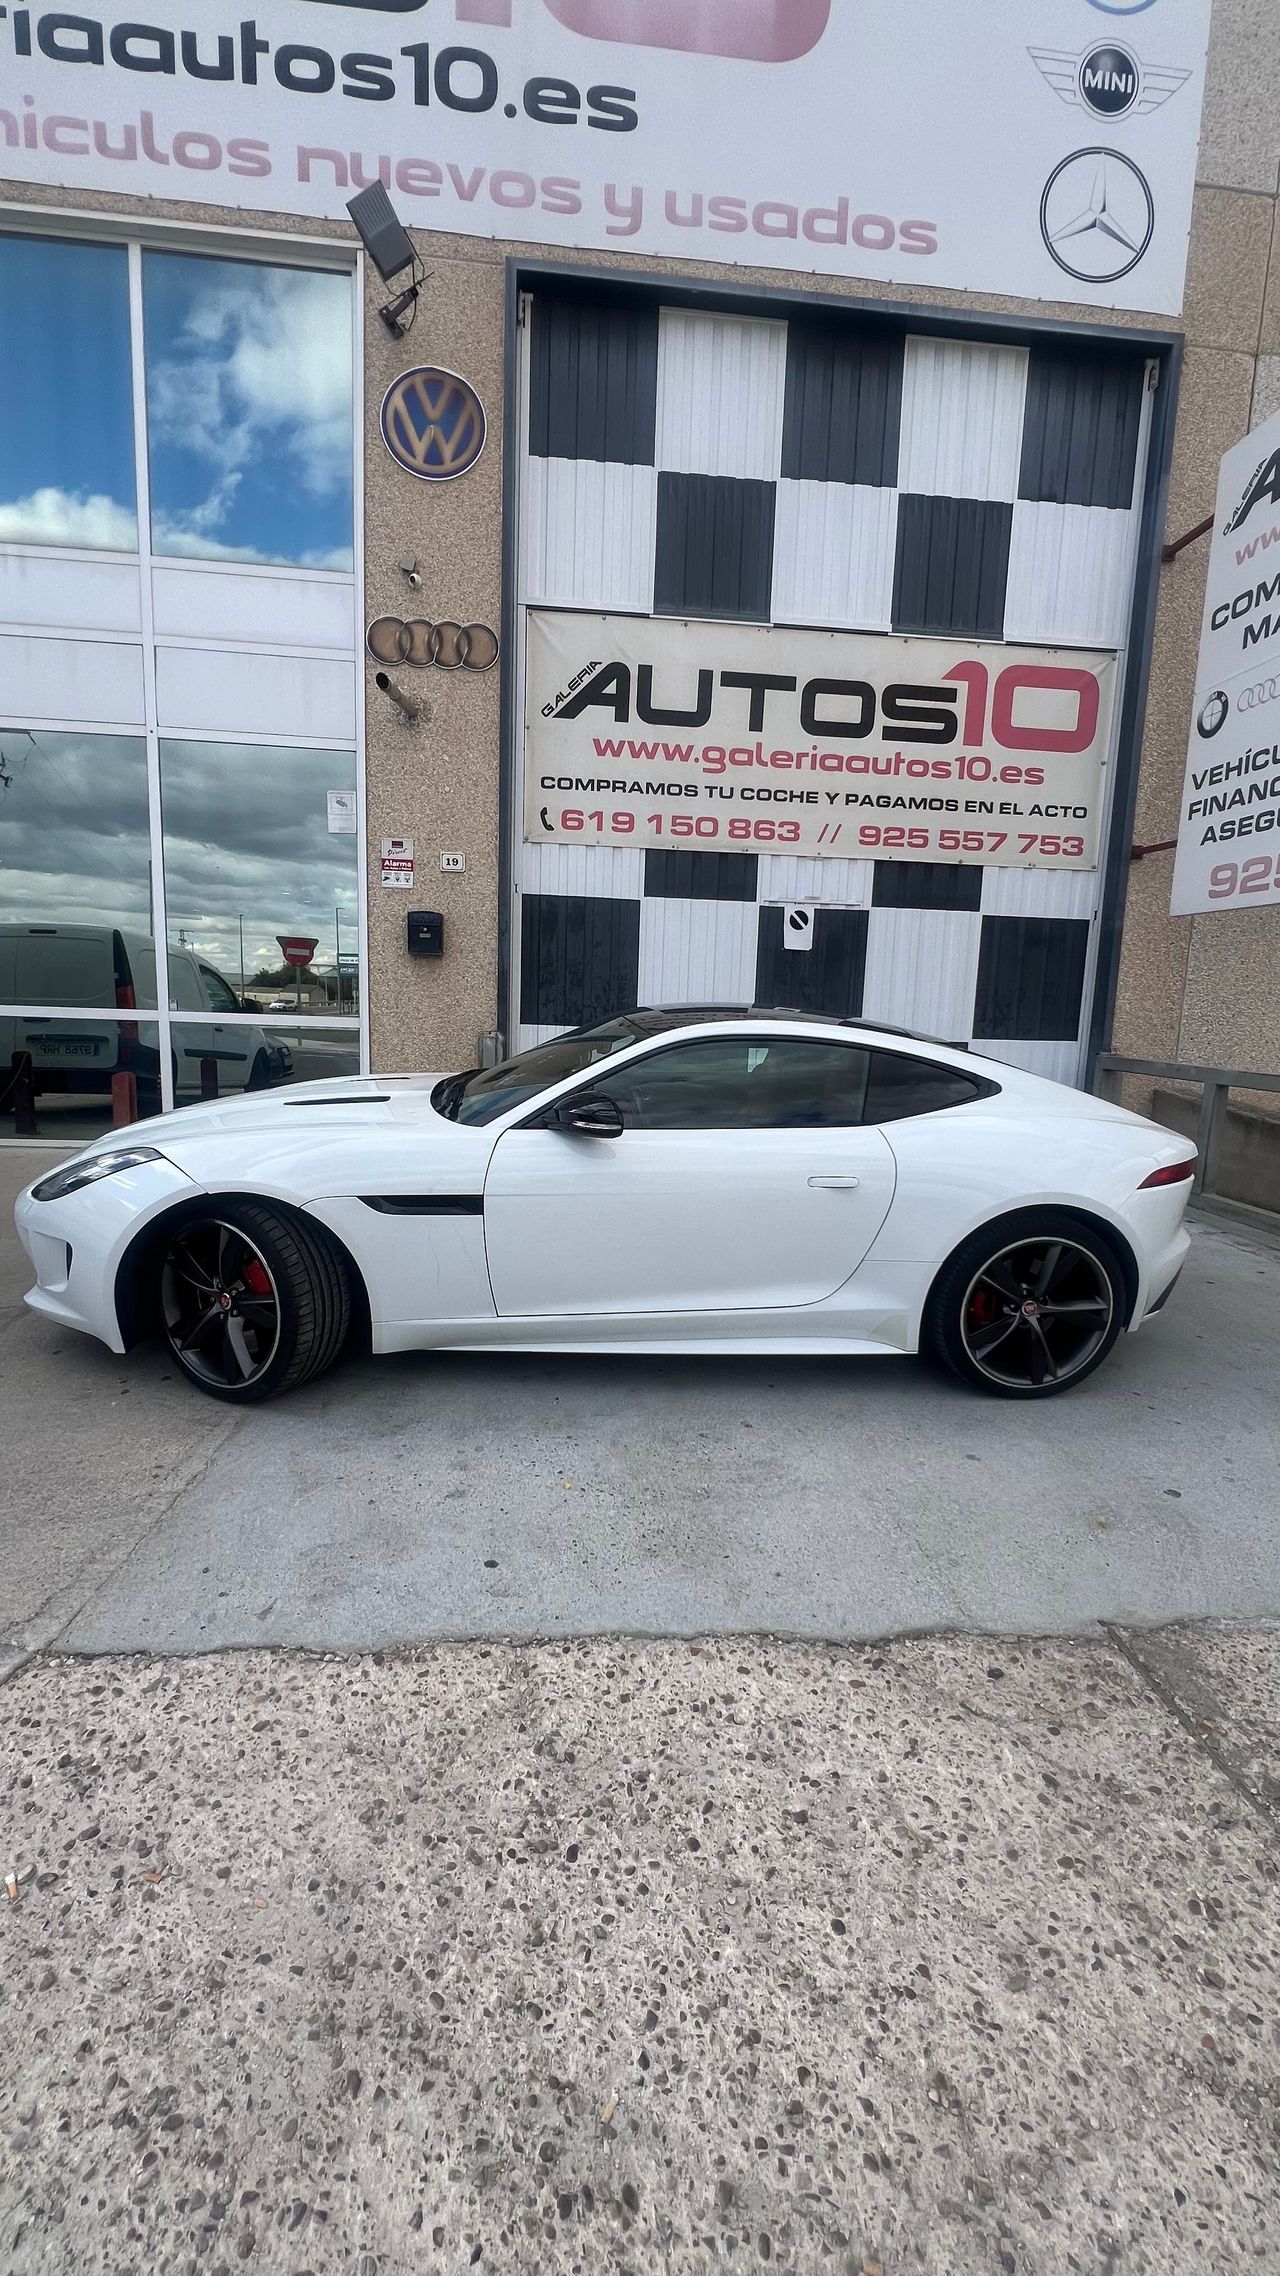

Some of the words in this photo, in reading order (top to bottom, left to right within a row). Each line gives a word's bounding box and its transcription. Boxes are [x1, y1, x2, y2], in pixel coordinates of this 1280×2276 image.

[1085, 68, 1133, 93] MINI
[297, 145, 582, 215] nuevos
[604, 183, 643, 236] y
[664, 190, 938, 256] usados
[540, 660, 603, 718] GALERIA
[552, 660, 1100, 754] AUTOS10
[592, 738, 1045, 786] www.galeriaautos10.es
[540, 775, 699, 798] COMPRAMOS
[704, 785, 734, 799] TU
[740, 787, 819, 804] COCHE
[824, 792, 840, 805] Y
[845, 793, 959, 812] PAGAMOS
[964, 800, 994, 814] EN
[999, 803, 1023, 816] EL
[1028, 804, 1088, 819] ACTO
[560, 809, 635, 833] 619
[646, 814, 719, 838] 150
[728, 818, 801, 842] 863
[858, 825, 930, 849] 925
[938, 829, 1008, 852] 557
[1017, 833, 1085, 857] 753
[1200, 807, 1280, 847] ASEG
[384, 859, 412, 868] Alarma
[445, 857, 459, 867] 19
[1208, 853, 1280, 899] 92
